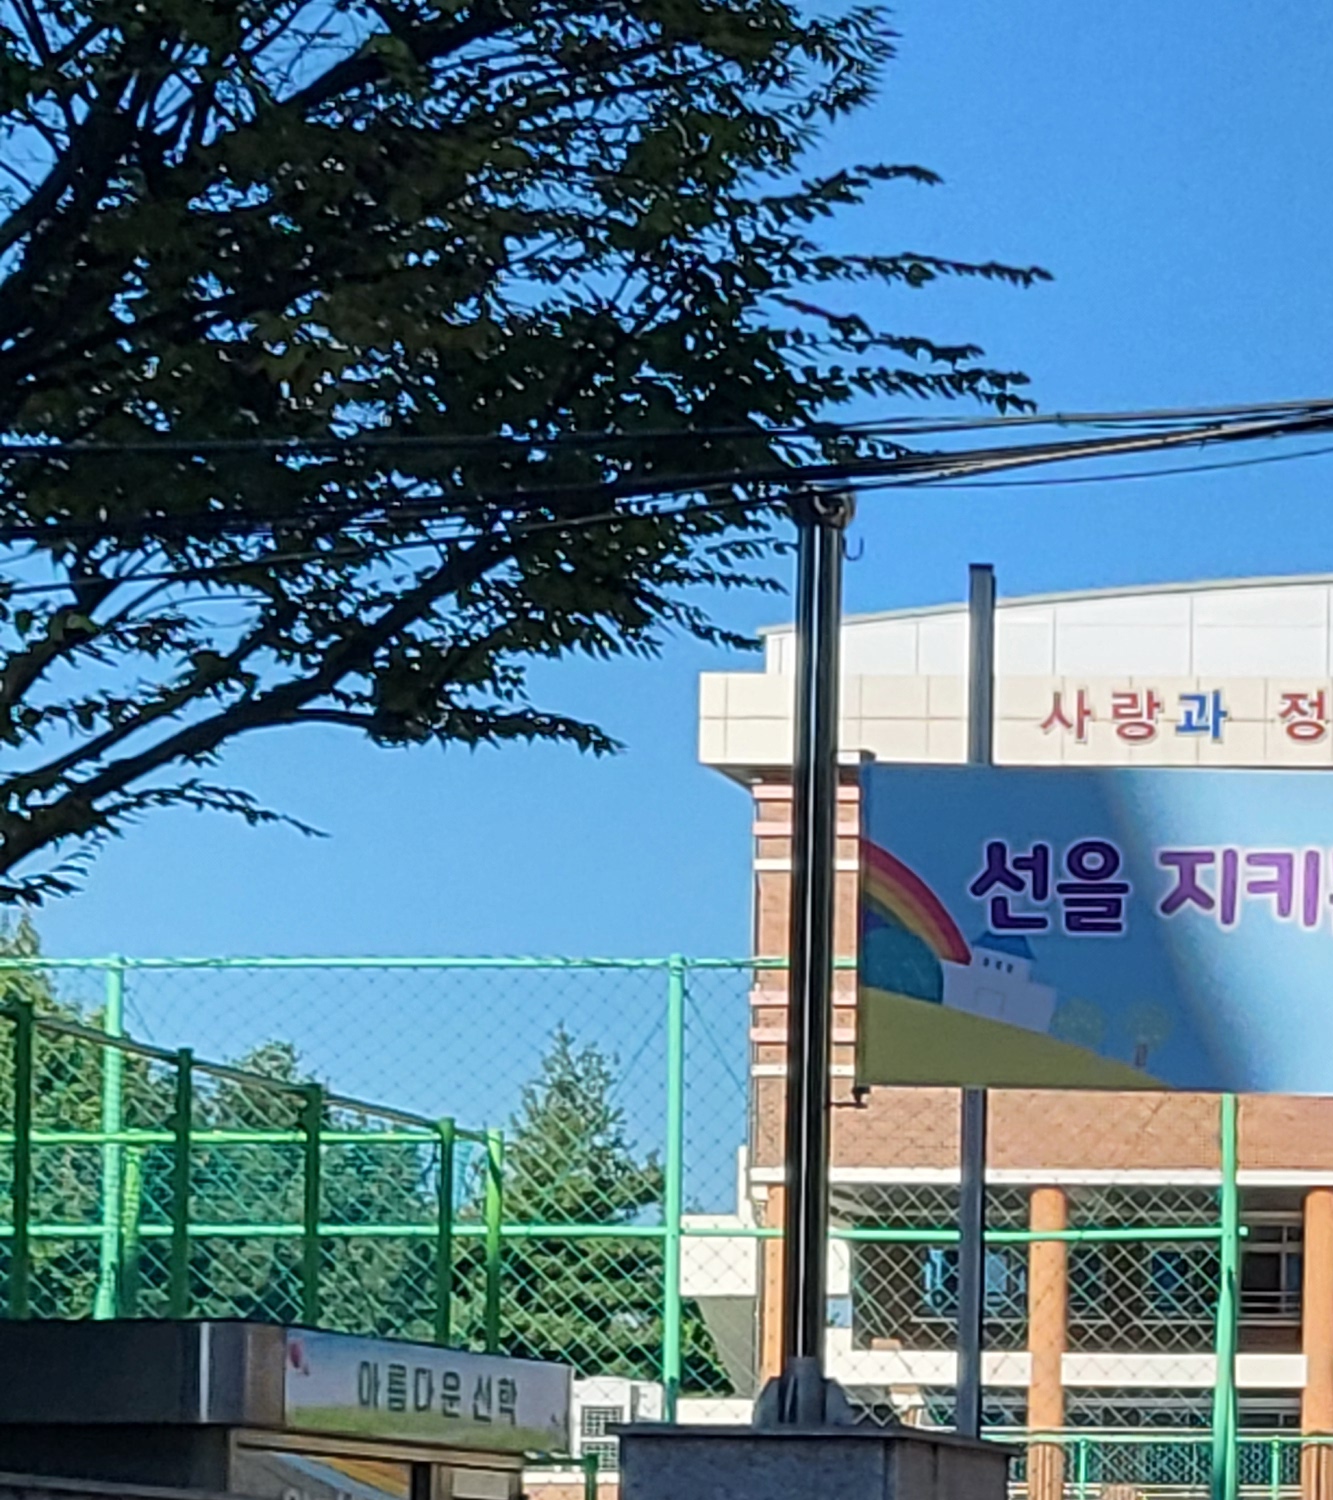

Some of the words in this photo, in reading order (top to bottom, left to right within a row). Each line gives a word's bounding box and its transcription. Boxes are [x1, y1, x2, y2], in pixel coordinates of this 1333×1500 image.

[1041, 689, 1228, 743] 사랑과
[970, 838, 1130, 934] 선을
[357, 1360, 463, 1419] 아름다운
[471, 1373, 519, 1427] 선학
